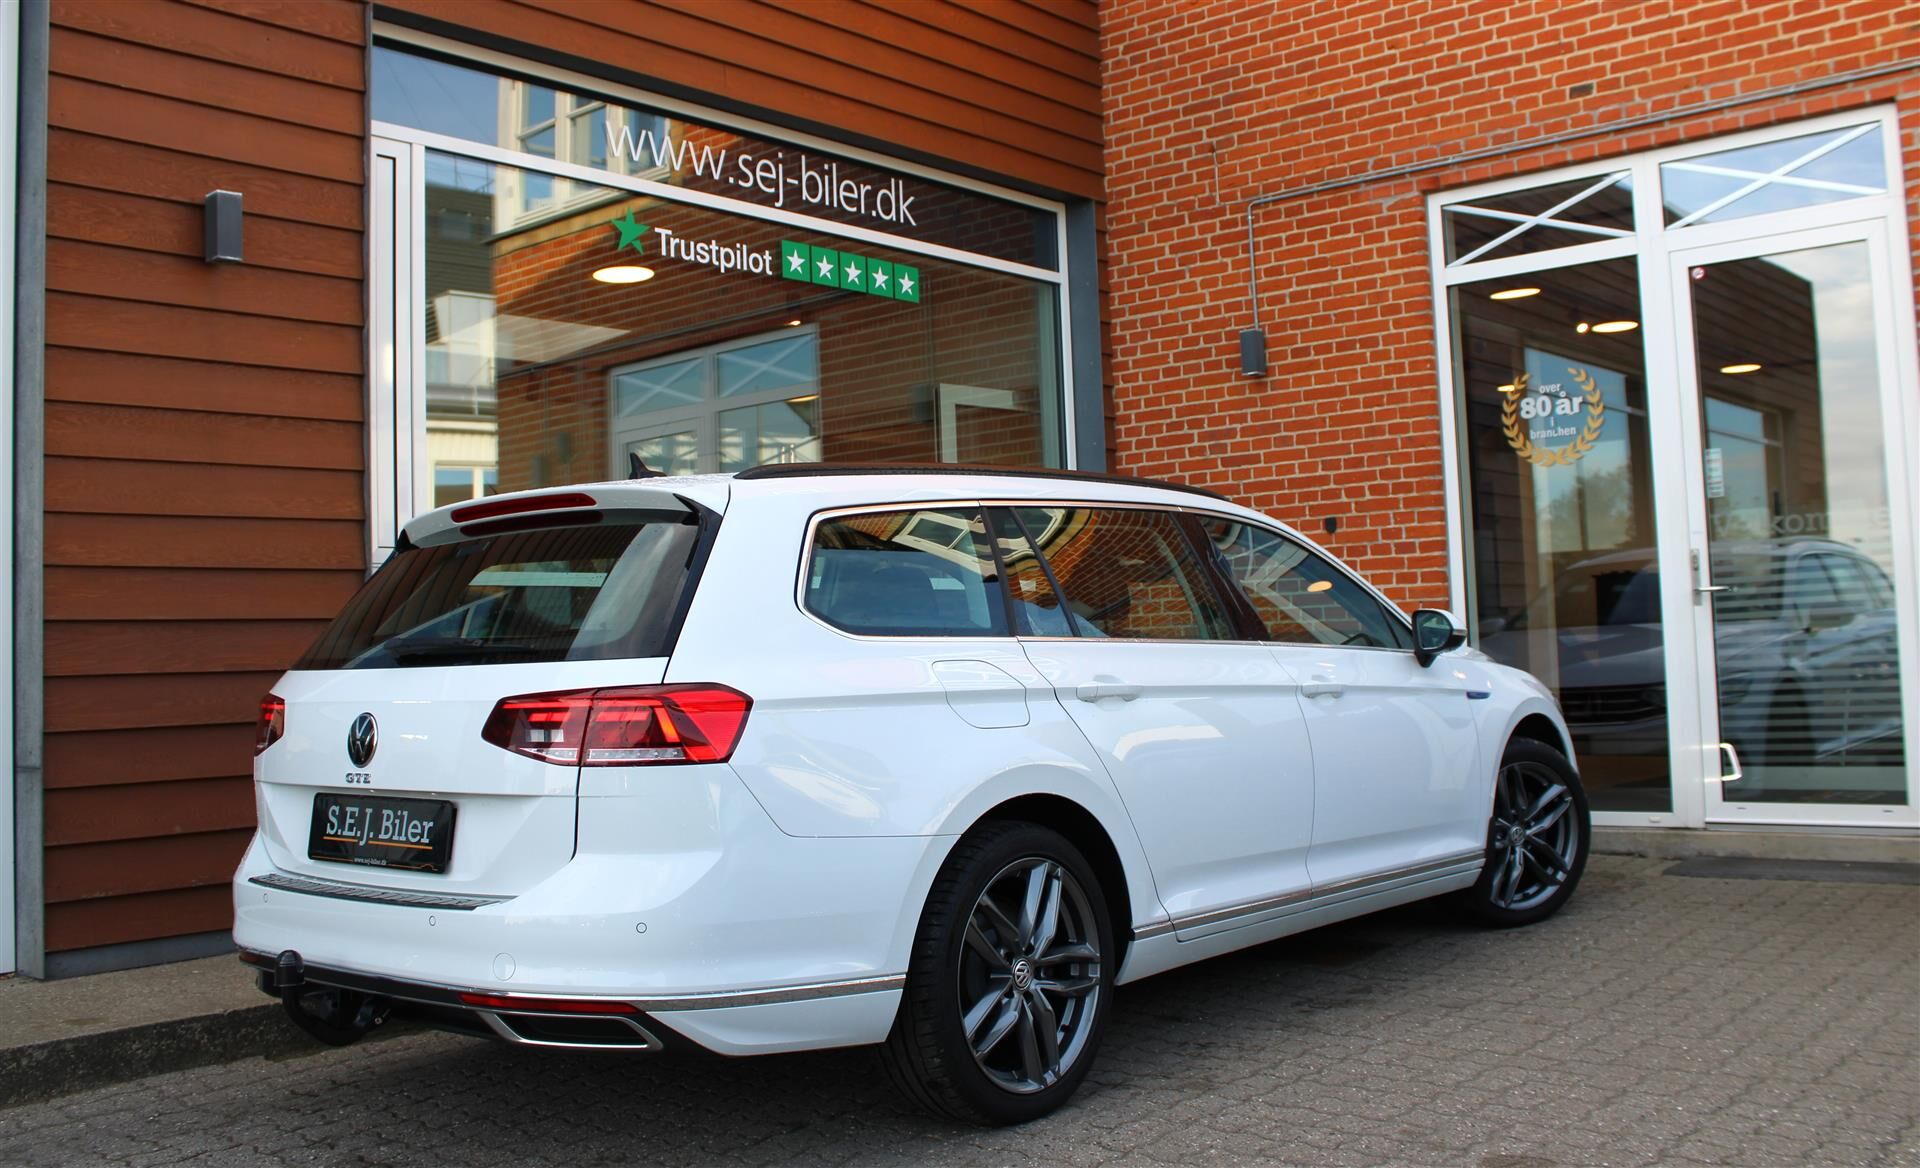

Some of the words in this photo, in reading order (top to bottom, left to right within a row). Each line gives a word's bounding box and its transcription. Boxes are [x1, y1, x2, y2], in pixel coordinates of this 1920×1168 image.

[605, 121, 917, 226] www.sej-biler.dk
[654, 227, 773, 276] Trustpilot
[1520, 395, 1552, 419] 80
[1555, 391, 1583, 415] år
[1539, 383, 1561, 393] over
[345, 772, 371, 784] GTE
[326, 804, 374, 846] S.E.J.
[378, 808, 434, 844] Biler
